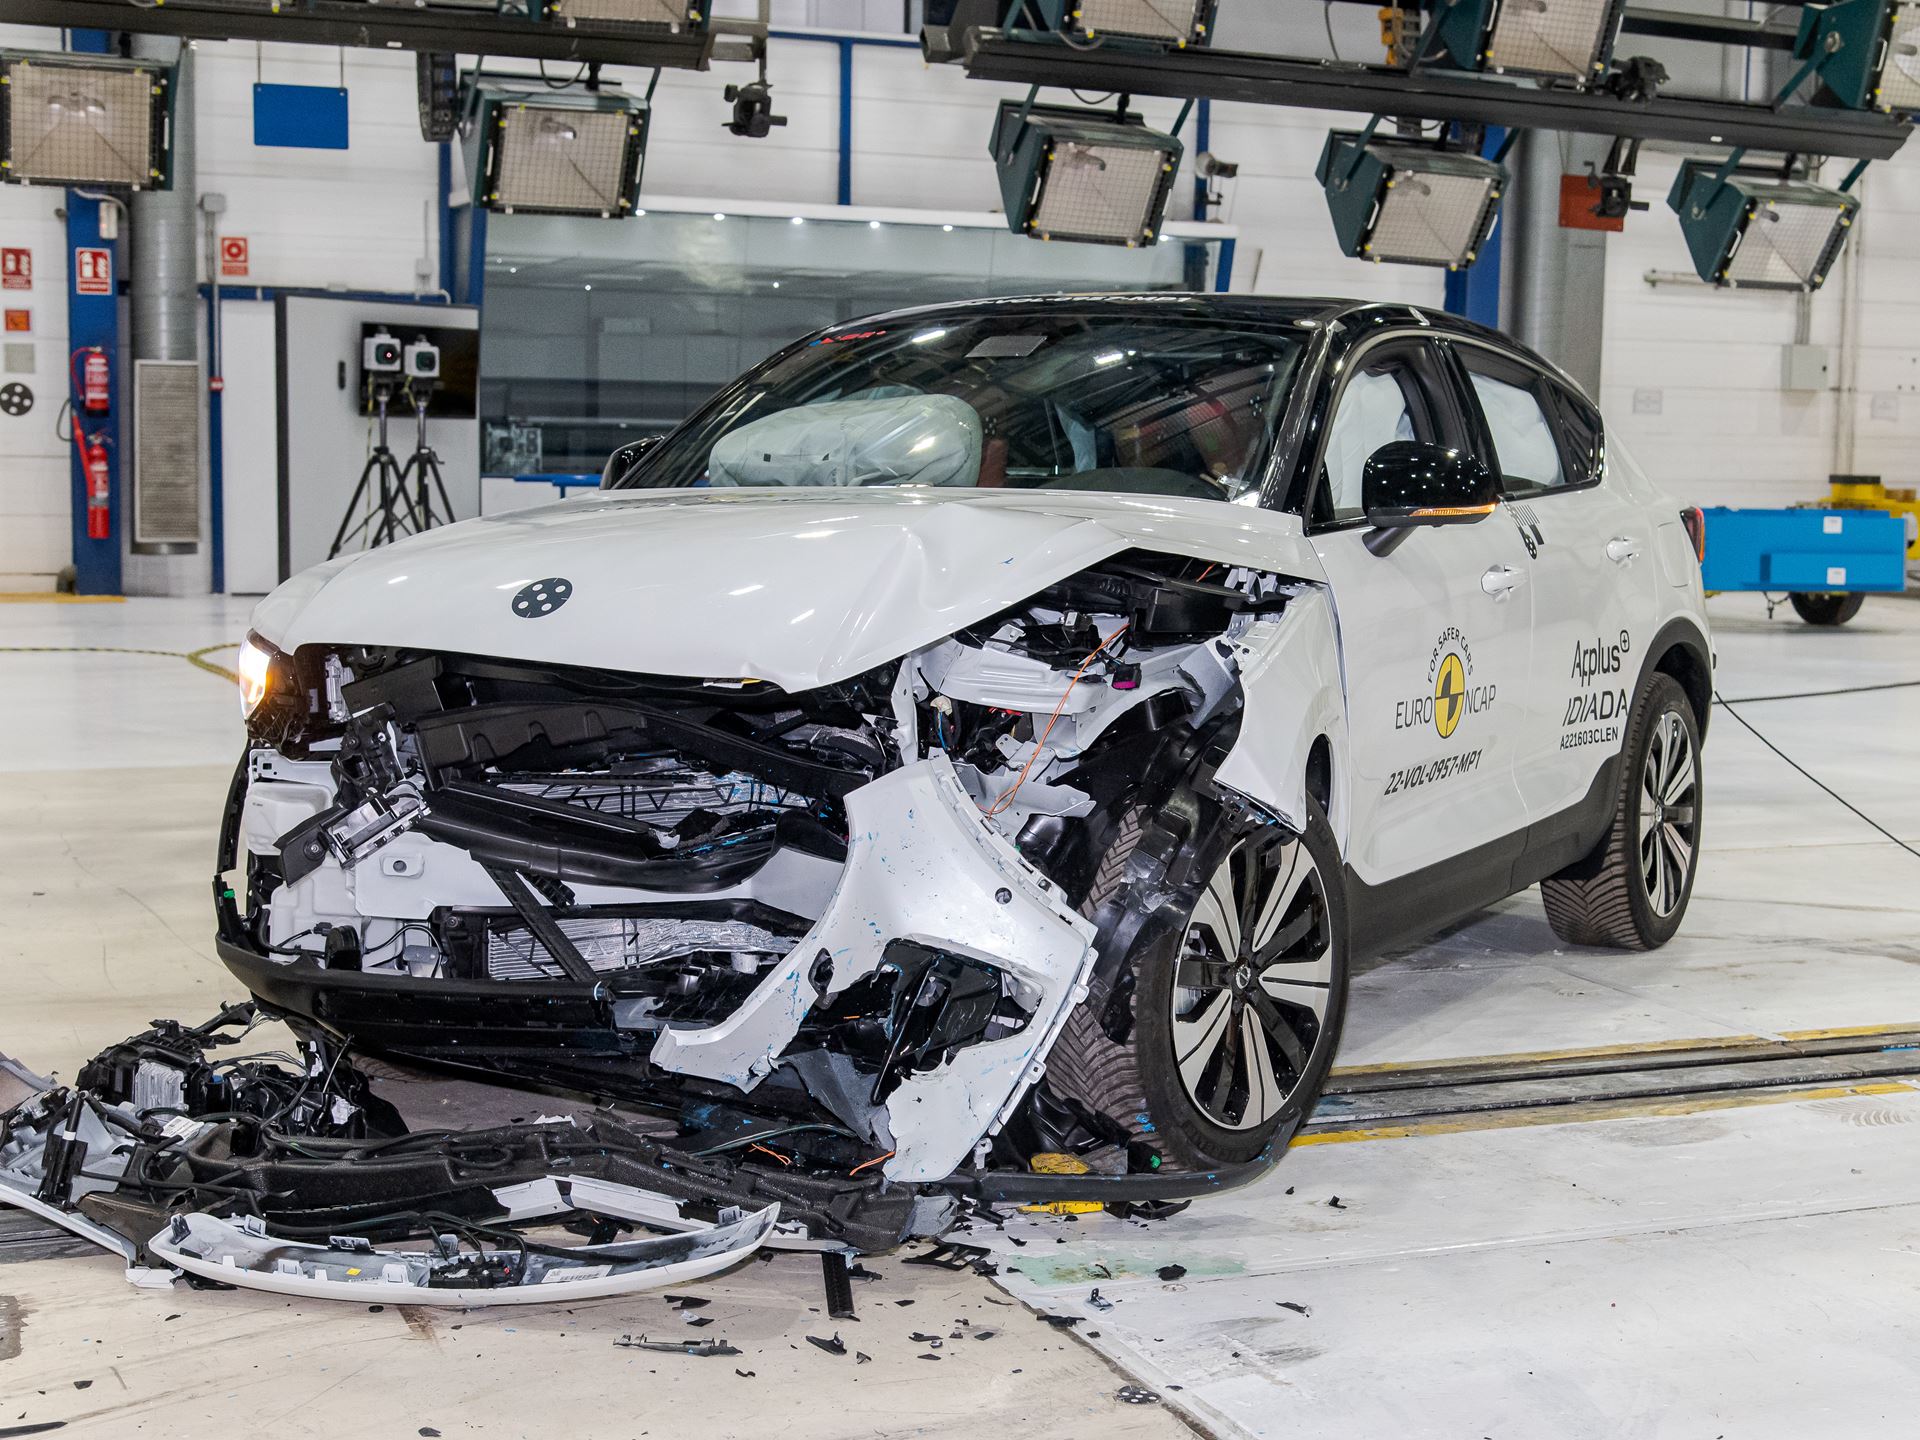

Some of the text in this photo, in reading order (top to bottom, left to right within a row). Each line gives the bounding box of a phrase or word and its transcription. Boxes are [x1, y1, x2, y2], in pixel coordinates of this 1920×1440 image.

[1427, 627, 1474, 684] FOR SAFER CARS
[1395, 684, 1497, 730] EURO NCAP
[1562, 688, 1628, 727] IDIADA
[1559, 726, 1619, 750] A221603CLEN
[1383, 748, 1483, 796] 22-VOL-0957-MP1
